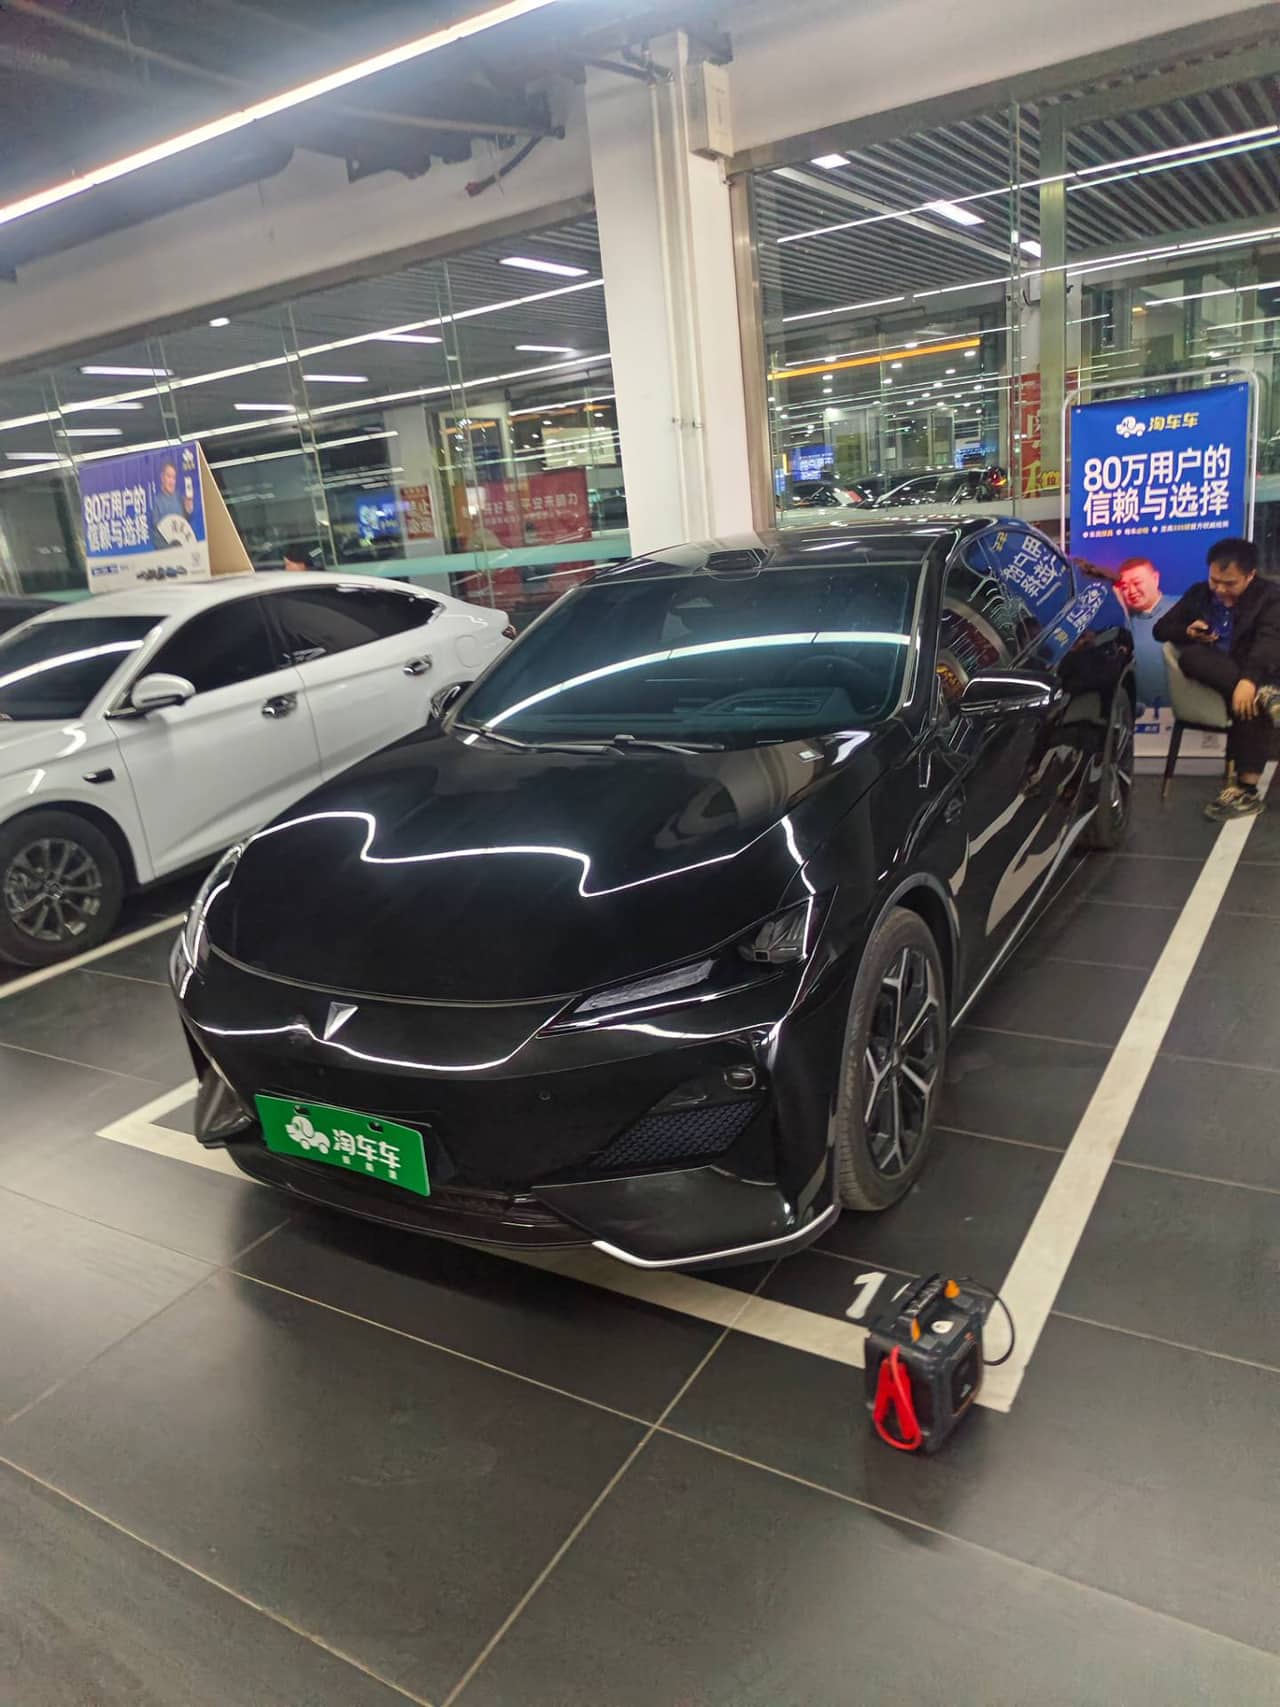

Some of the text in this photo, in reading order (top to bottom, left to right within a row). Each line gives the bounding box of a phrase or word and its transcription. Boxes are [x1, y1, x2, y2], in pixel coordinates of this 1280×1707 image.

[1148, 412, 1199, 432] 淘车车
[1083, 443, 1231, 492] 80万用户的
[84, 483, 147, 524] 80万用户的
[1083, 479, 1230, 526] 信赖与选择
[332, 1128, 401, 1169] 淘车车
